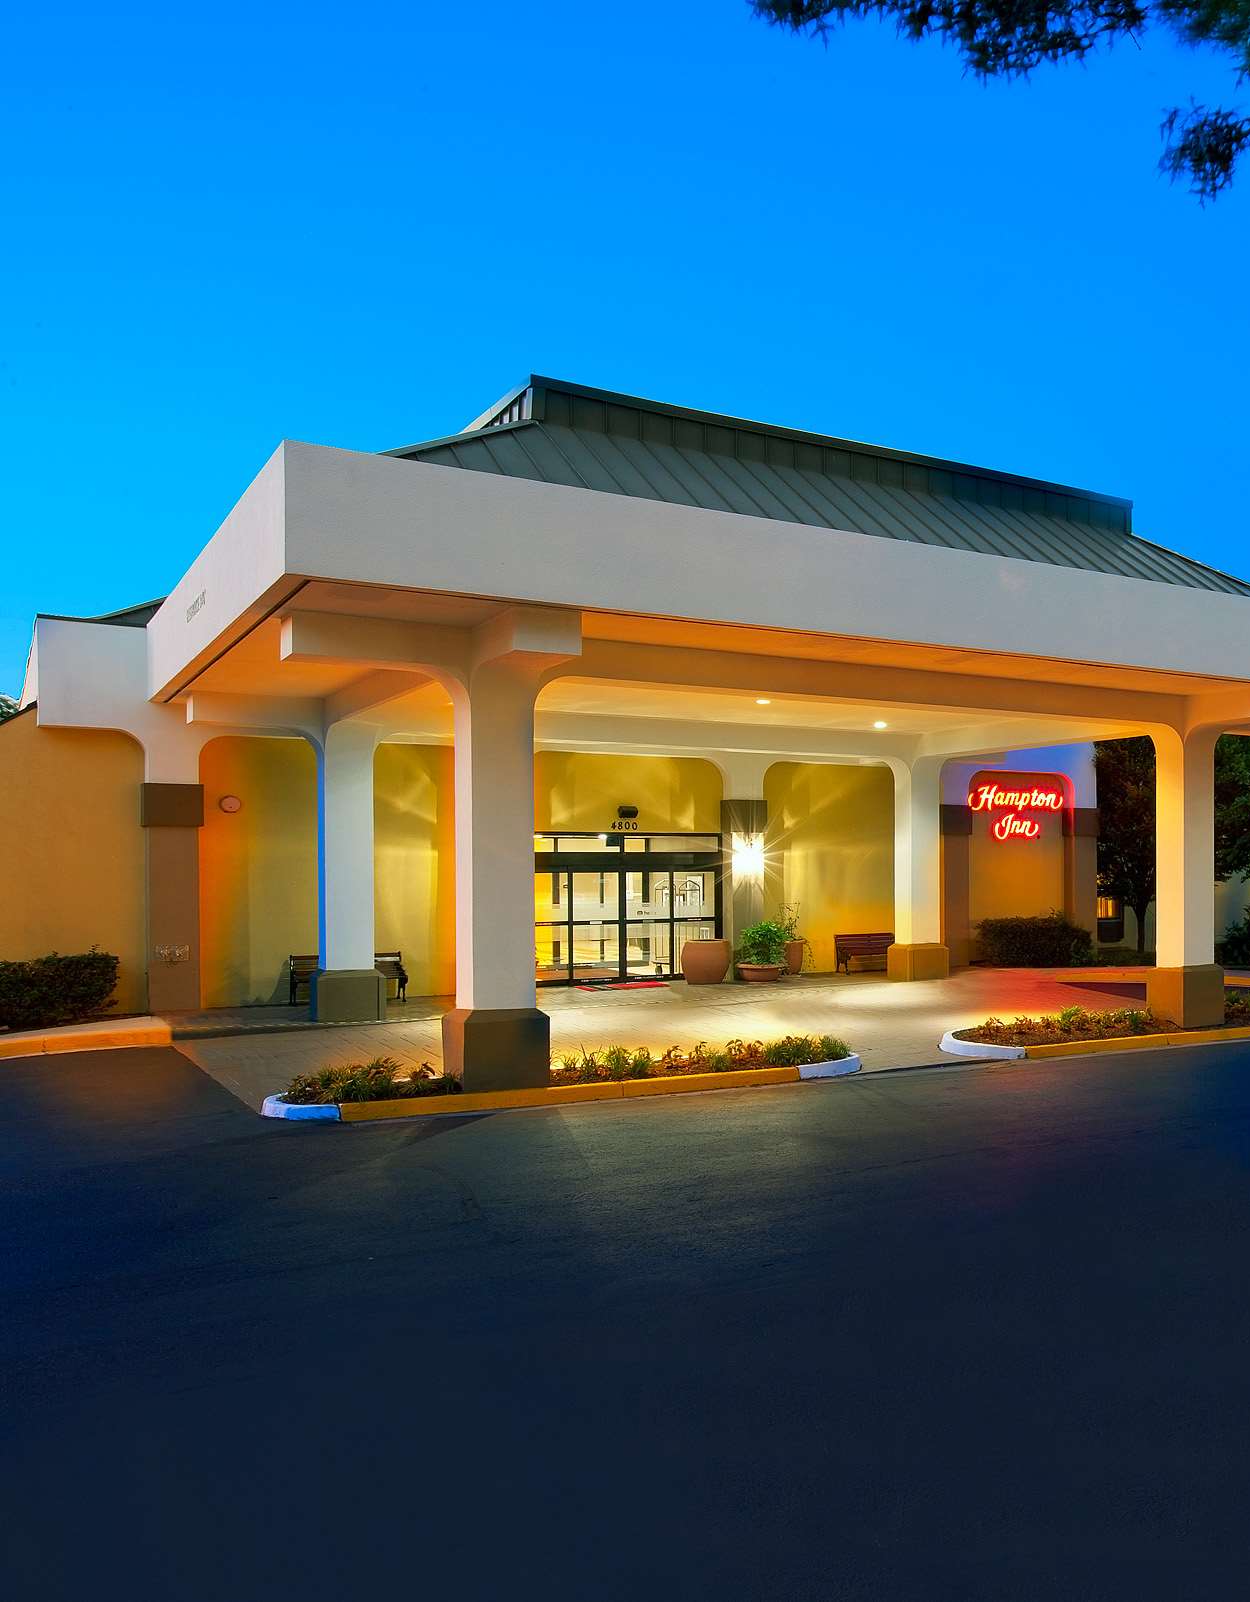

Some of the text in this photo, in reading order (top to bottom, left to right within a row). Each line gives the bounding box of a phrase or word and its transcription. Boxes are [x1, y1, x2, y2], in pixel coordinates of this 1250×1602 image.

[967, 785, 1063, 811] Hampton
[611, 821, 638, 830] 4800
[994, 813, 1039, 840] Inn
